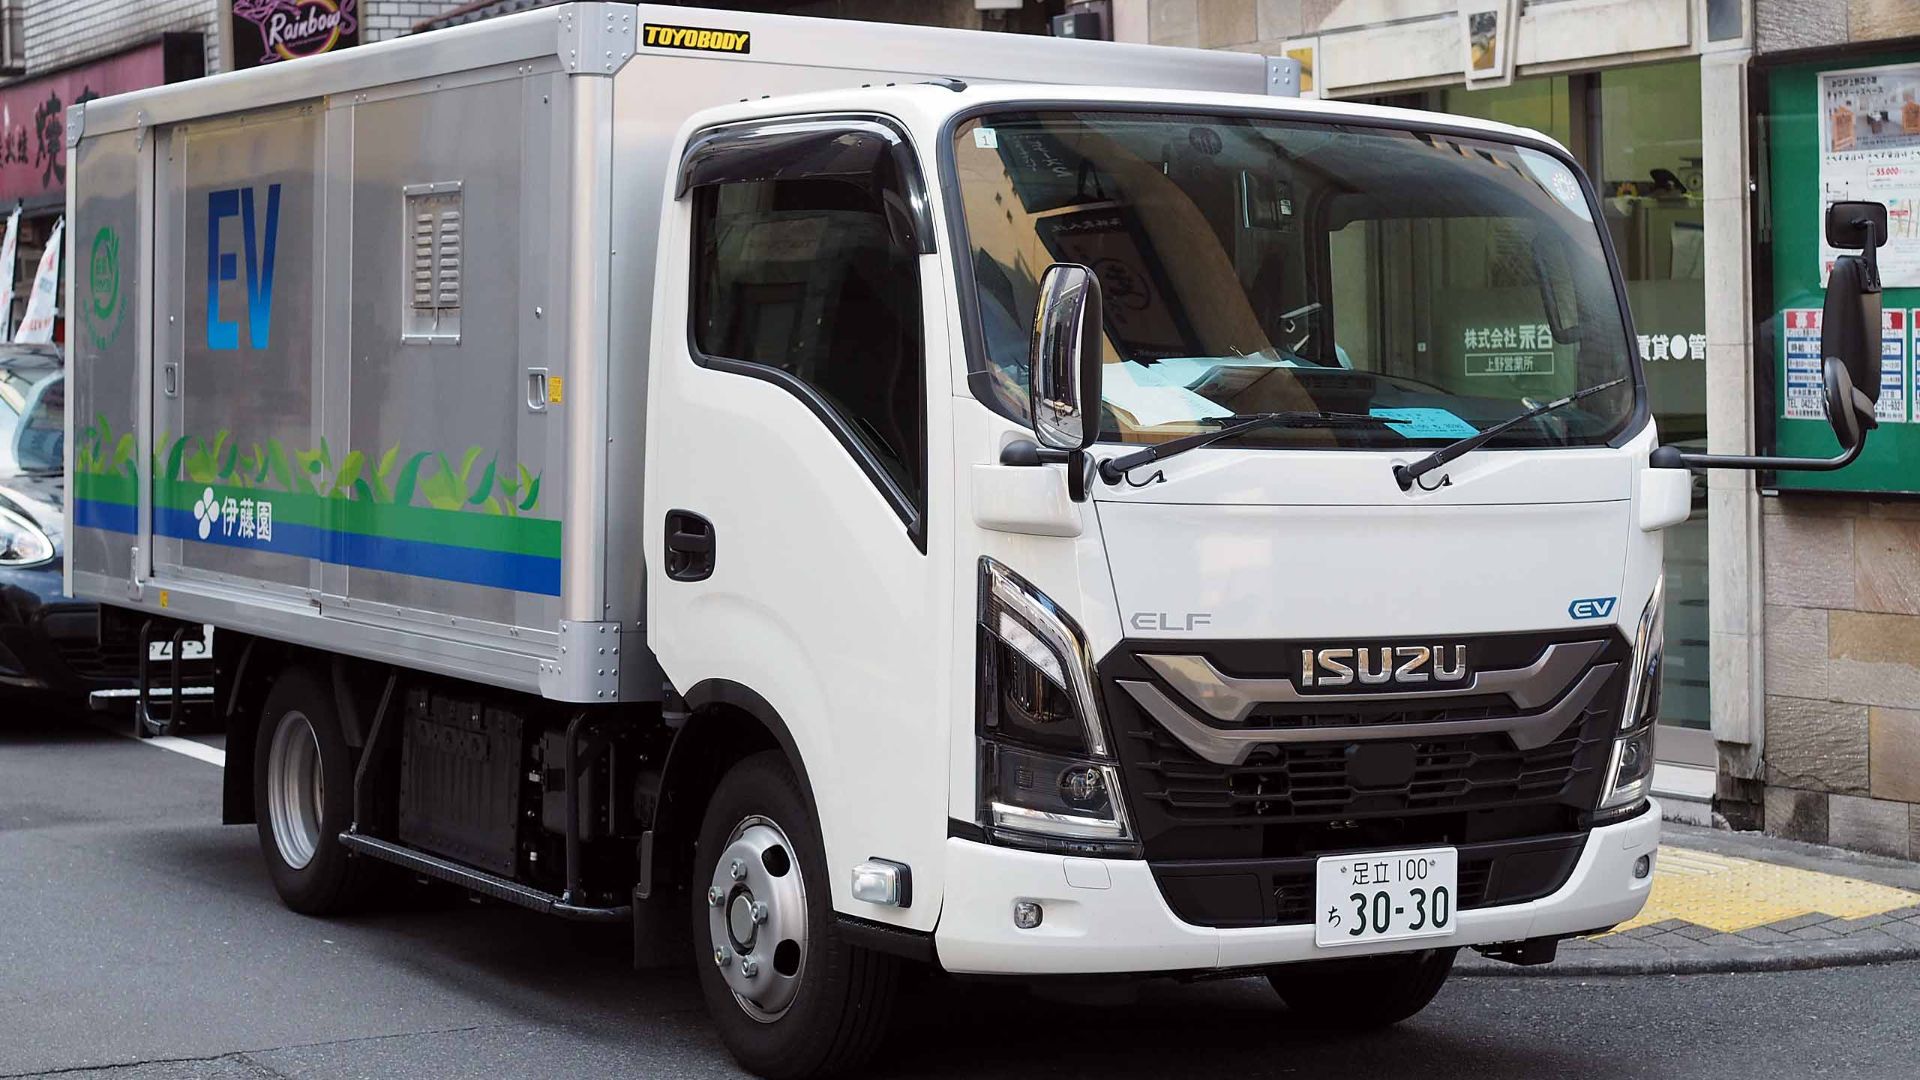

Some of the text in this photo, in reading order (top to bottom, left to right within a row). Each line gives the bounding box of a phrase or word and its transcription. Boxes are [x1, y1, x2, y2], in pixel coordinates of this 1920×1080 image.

[269, 6, 340, 46] Rainbow
[645, 26, 748, 50] TOYOBODY
[207, 184, 281, 349] EV
[1484, 356, 1534, 372] 上野営業所
[221, 496, 273, 542] 伊藤園
[1130, 612, 1211, 631] ELF
[1573, 600, 1611, 617] EV
[1301, 644, 1467, 687] ISUZU
[1352, 858, 1428, 885] 足立 100
[1327, 886, 1449, 936] ち 30-30
